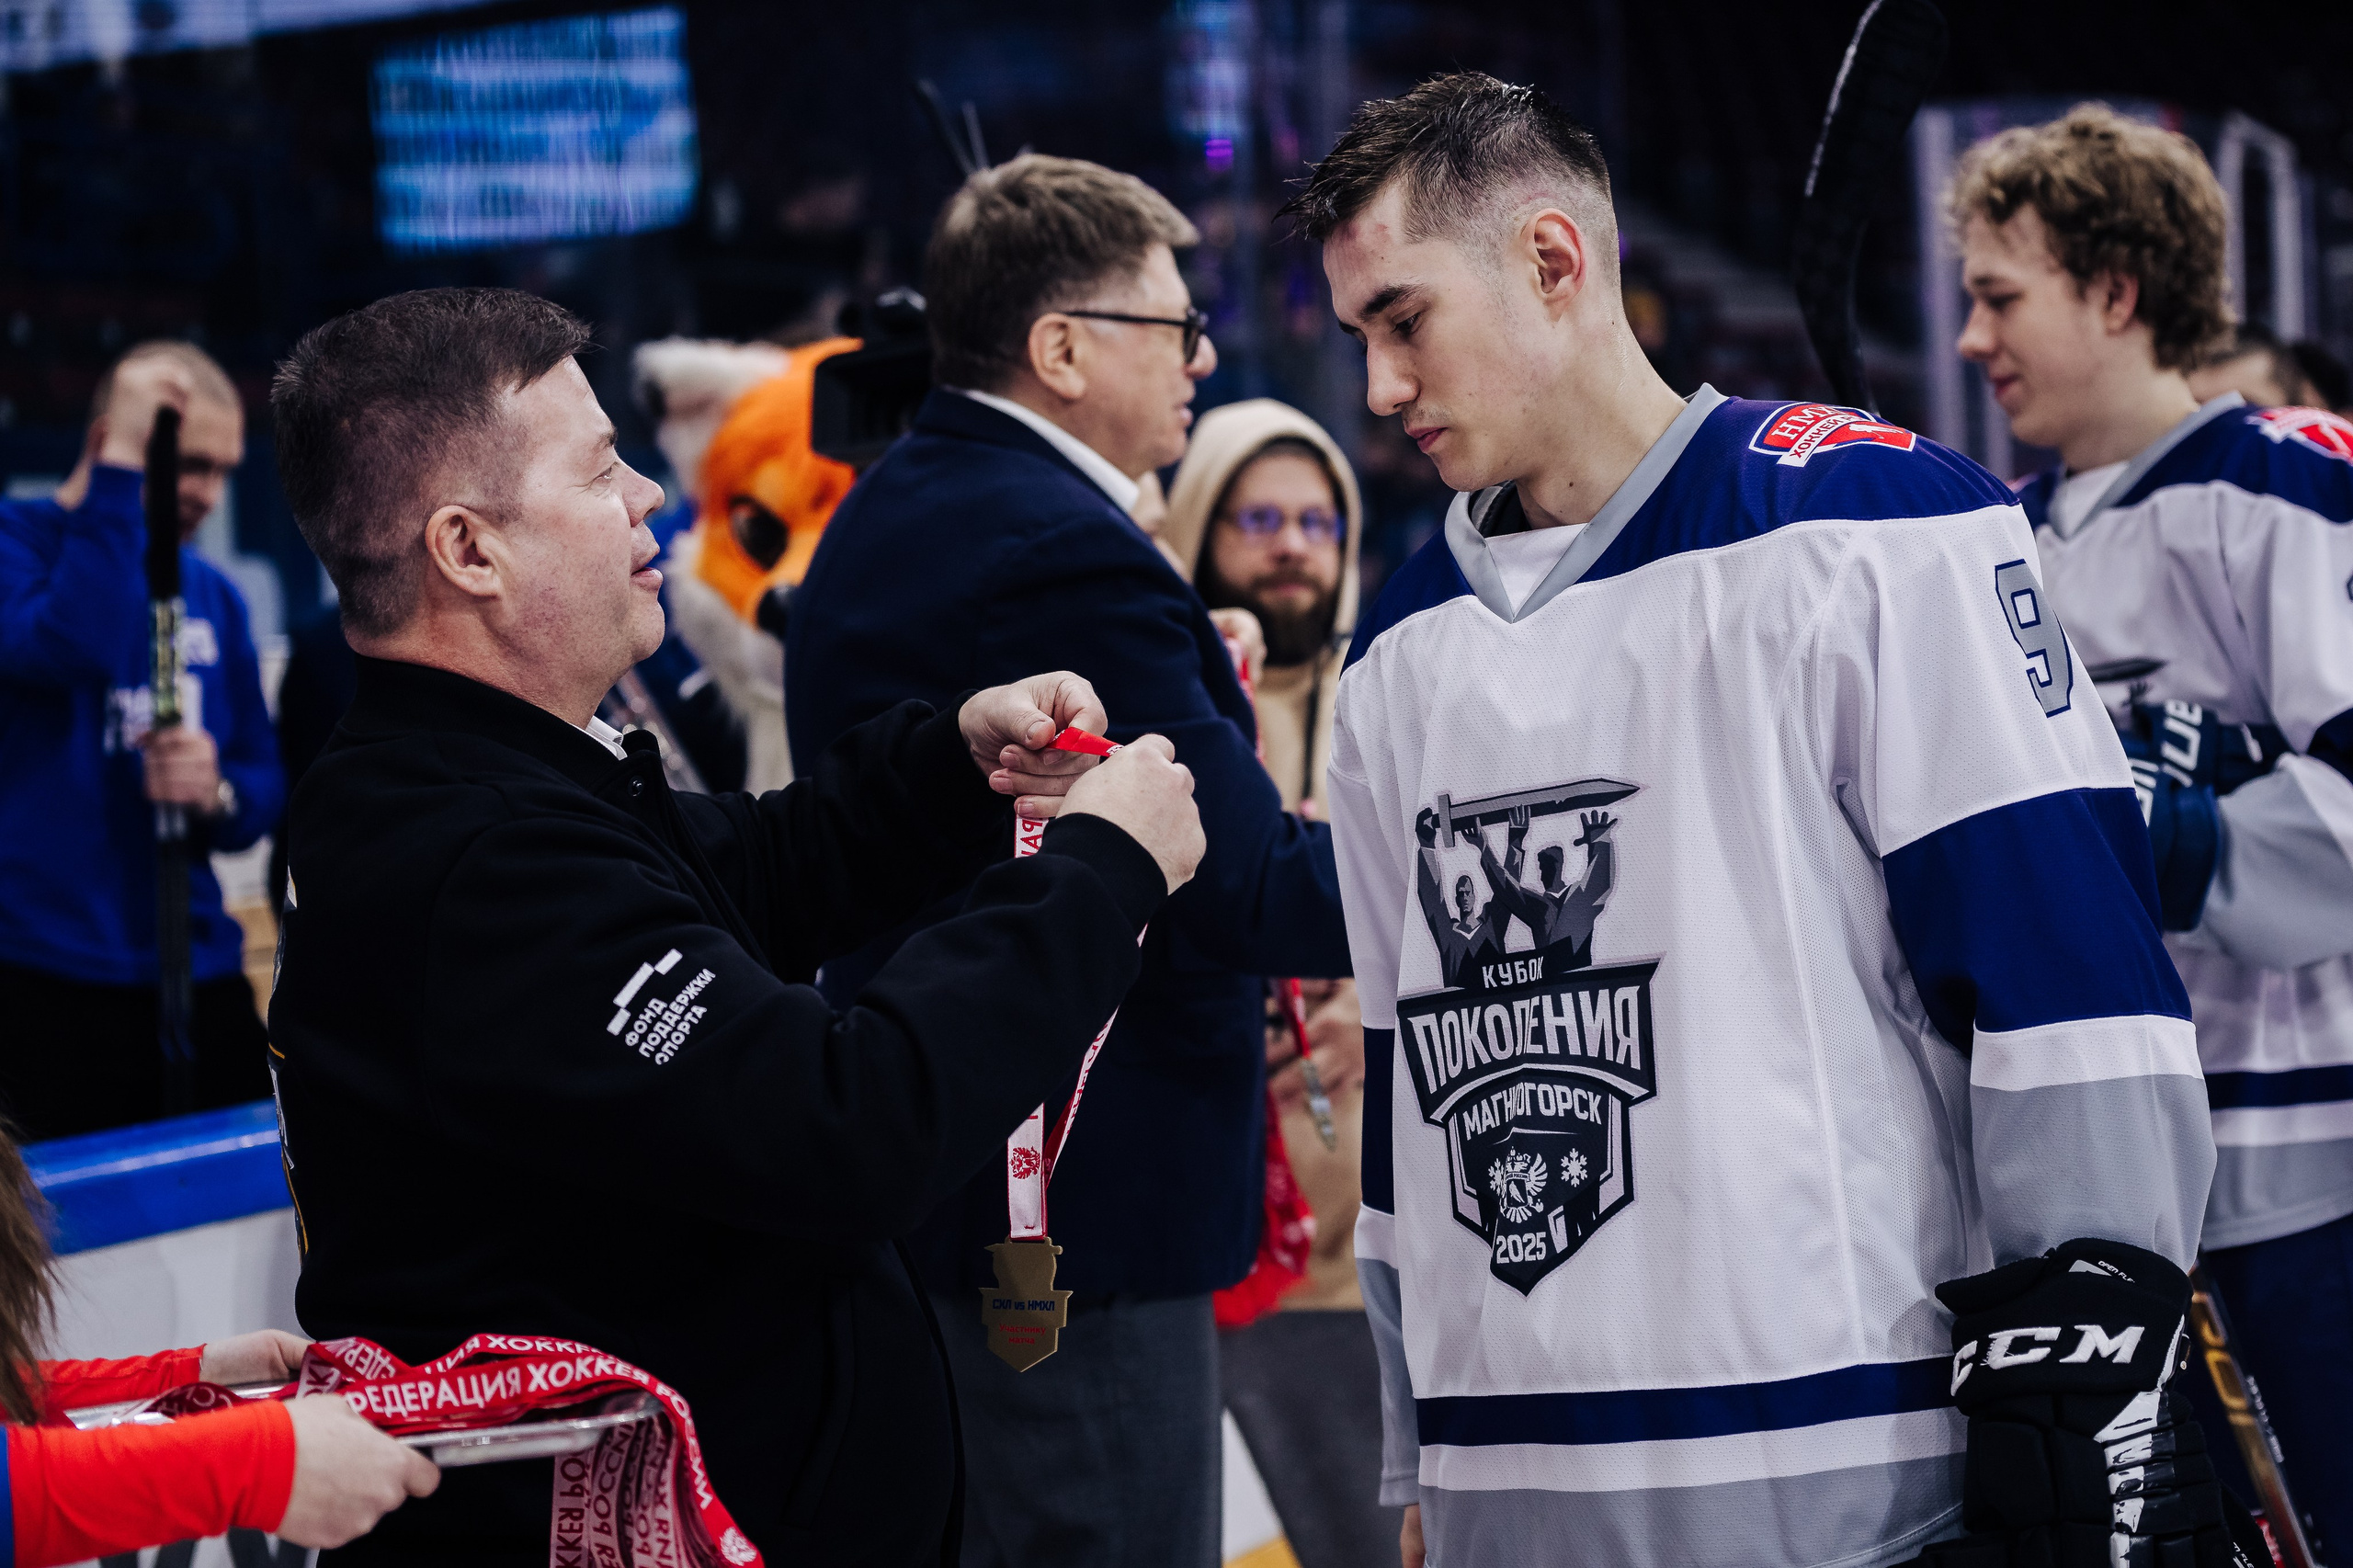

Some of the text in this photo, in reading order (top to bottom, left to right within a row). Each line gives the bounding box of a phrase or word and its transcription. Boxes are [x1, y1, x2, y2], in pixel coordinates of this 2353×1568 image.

[1995, 558, 2074, 718] 9
[1482, 956, 1544, 988] КУБОК
[625, 997, 668, 1047] ФОНД
[638, 968, 716, 1058] ПОДДЕРЖКИ
[654, 1005, 708, 1065] СПОРТА
[1407, 985, 1641, 1095] ПОКОЛЕНИЯ
[1495, 1232, 1547, 1264] 2025
[1028, 1300, 1055, 1312] НМХЛ
[1950, 1324, 2145, 1396] CCM
